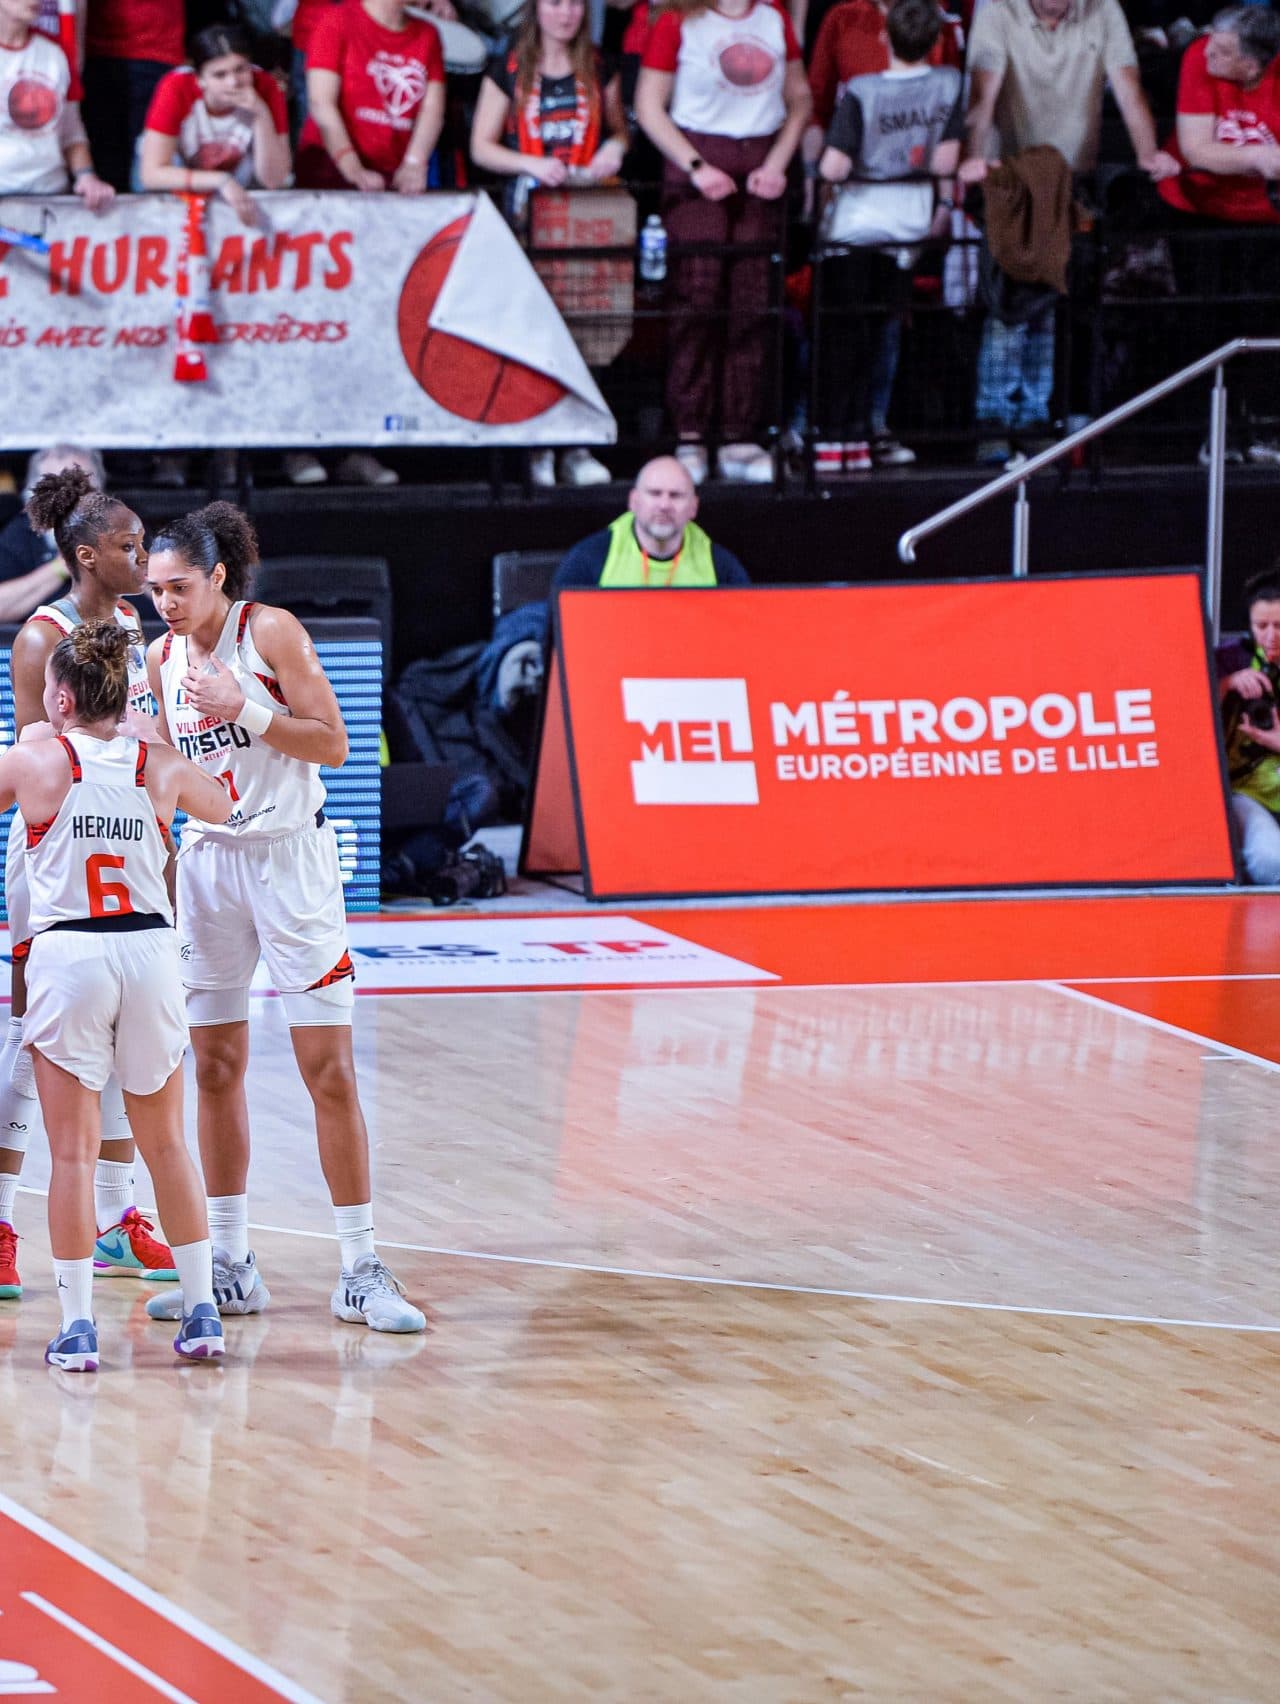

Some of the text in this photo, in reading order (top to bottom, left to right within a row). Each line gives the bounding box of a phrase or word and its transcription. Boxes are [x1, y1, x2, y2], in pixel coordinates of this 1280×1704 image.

[49, 231, 354, 297] HURANTS
[217, 313, 350, 345] ERRIÈRES
[771, 688, 1157, 747] MÉTROPOLE
[776, 742, 1160, 781] EUROPÉENNE DE LILLE
[72, 815, 144, 842] HERIAUD
[85, 853, 135, 918] 6
